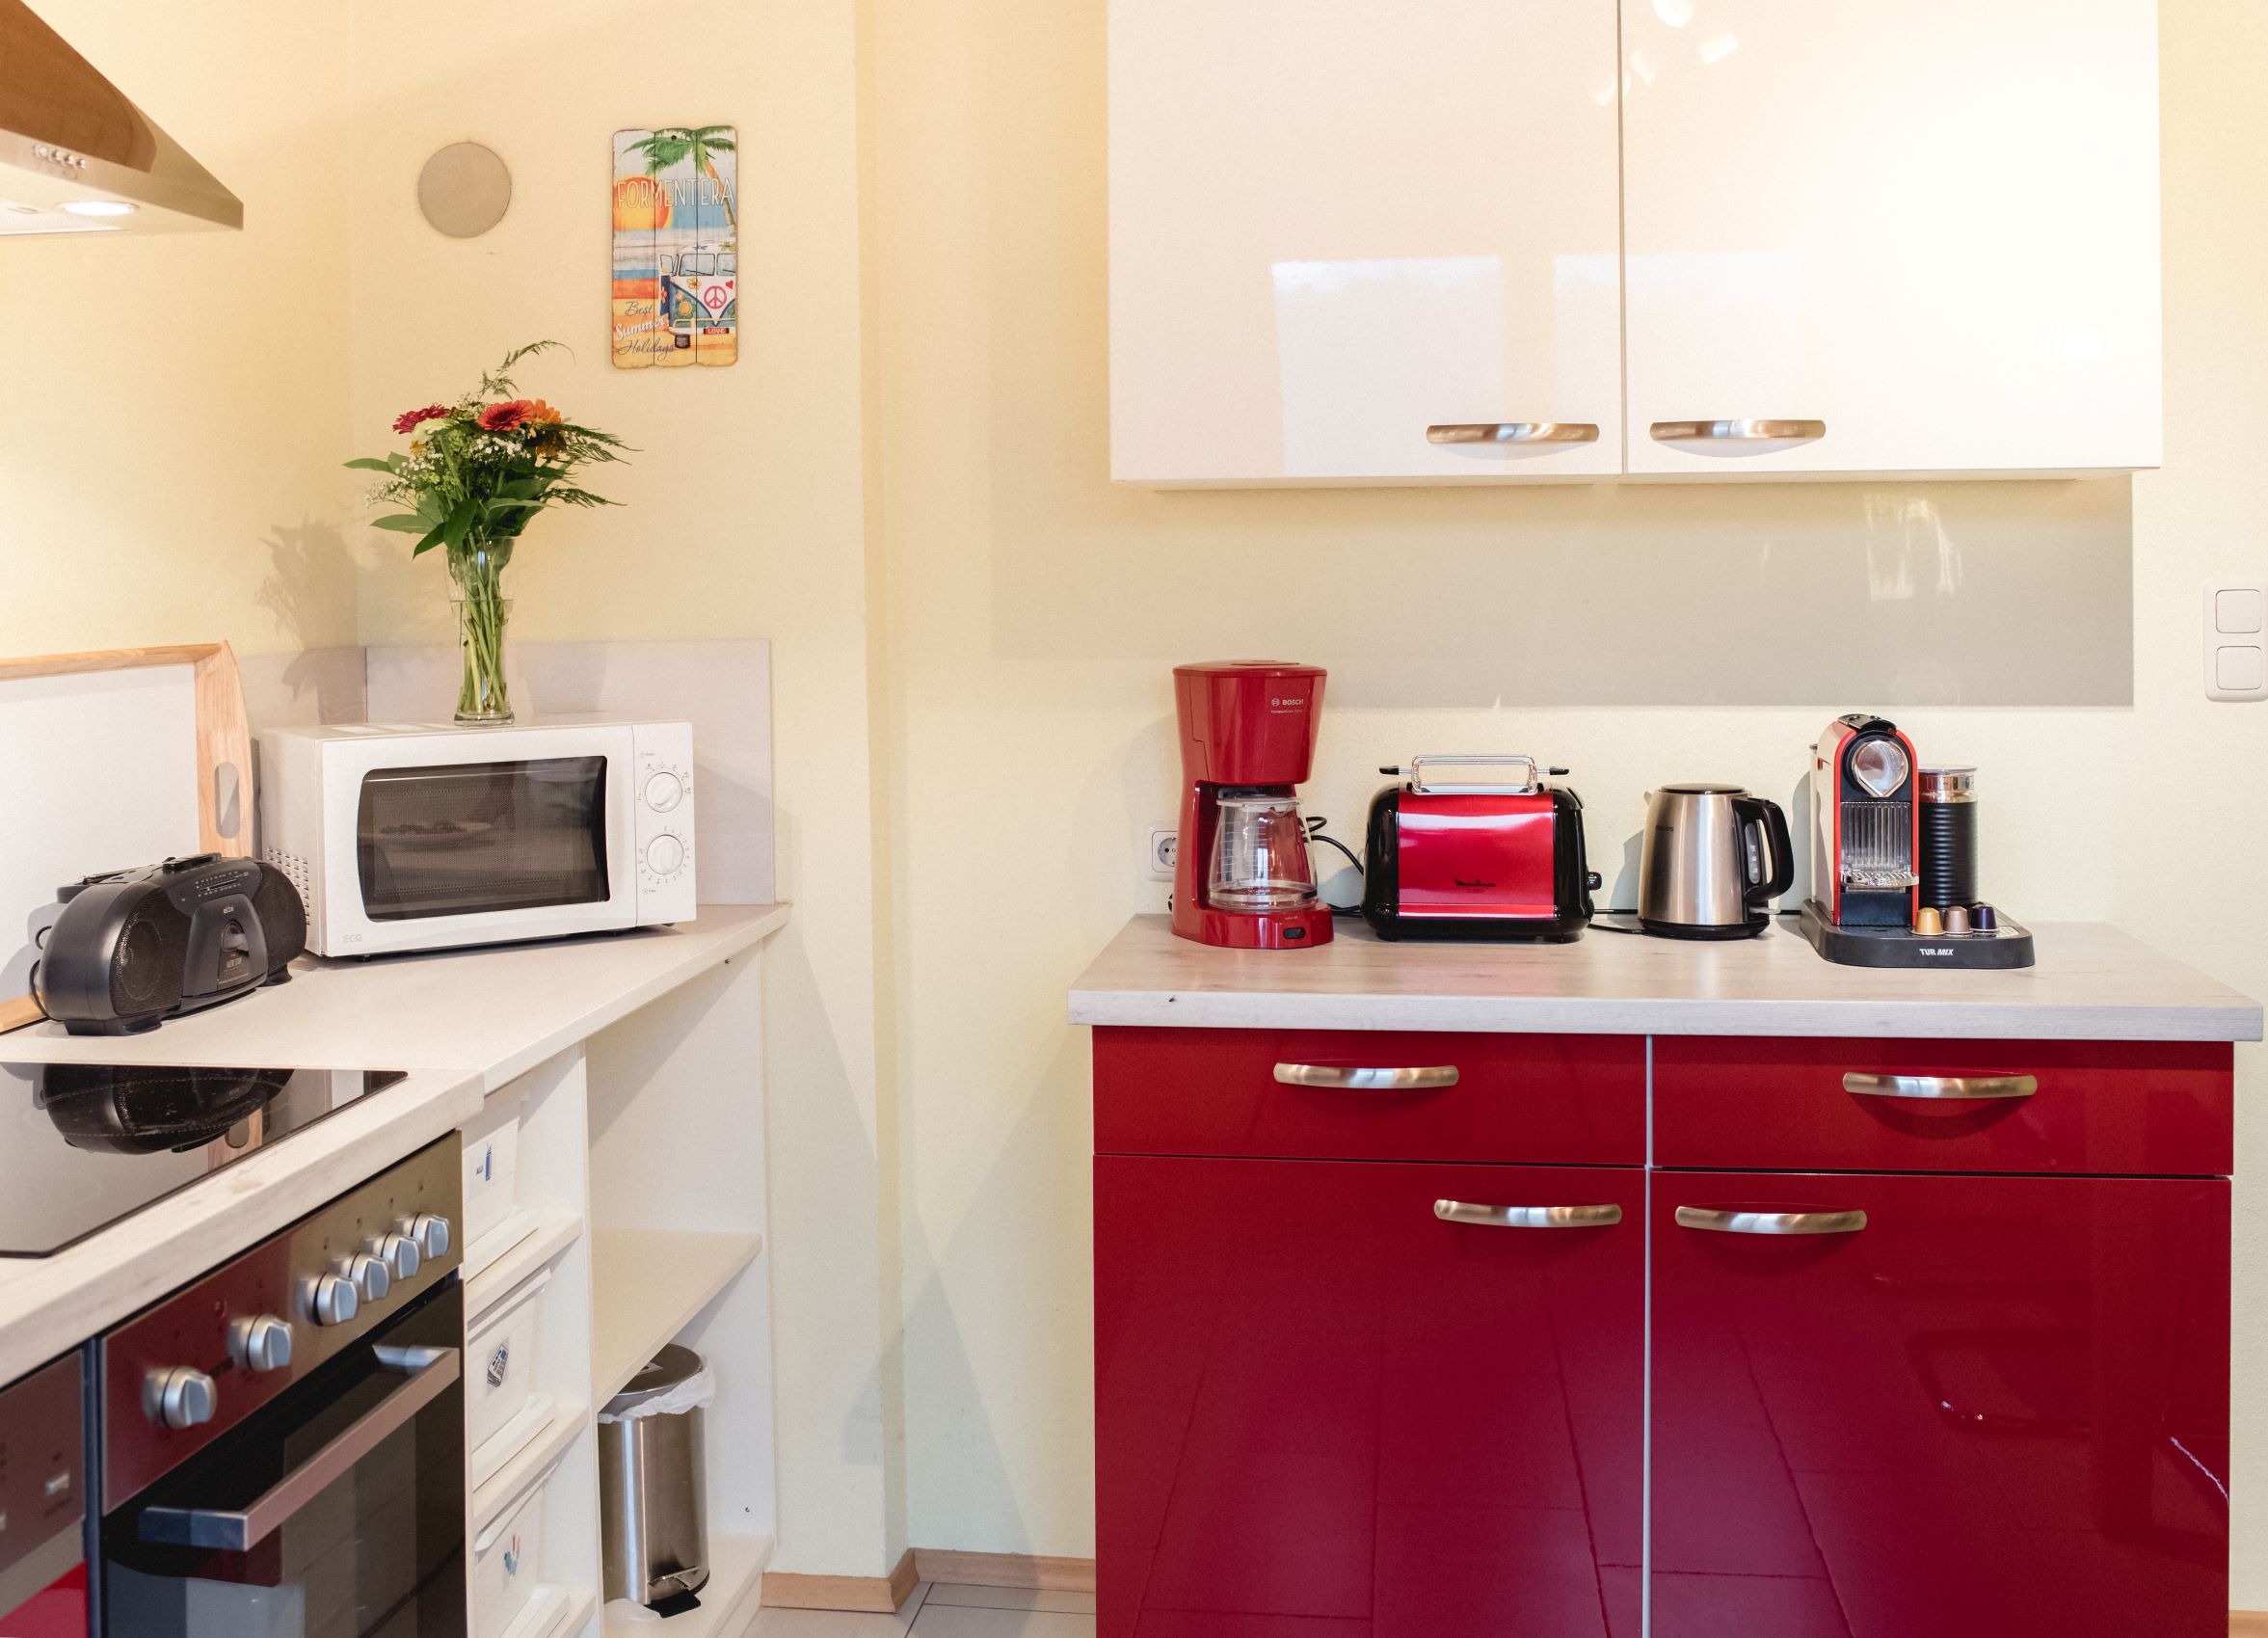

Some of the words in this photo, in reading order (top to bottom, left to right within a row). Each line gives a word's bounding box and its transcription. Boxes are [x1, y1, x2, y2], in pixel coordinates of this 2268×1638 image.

[616, 177, 734, 208] FORMENTERA
[625, 301, 654, 316] Best
[615, 314, 665, 339] Summer
[617, 337, 675, 362] Holidays
[342, 933, 362, 943] ECG
